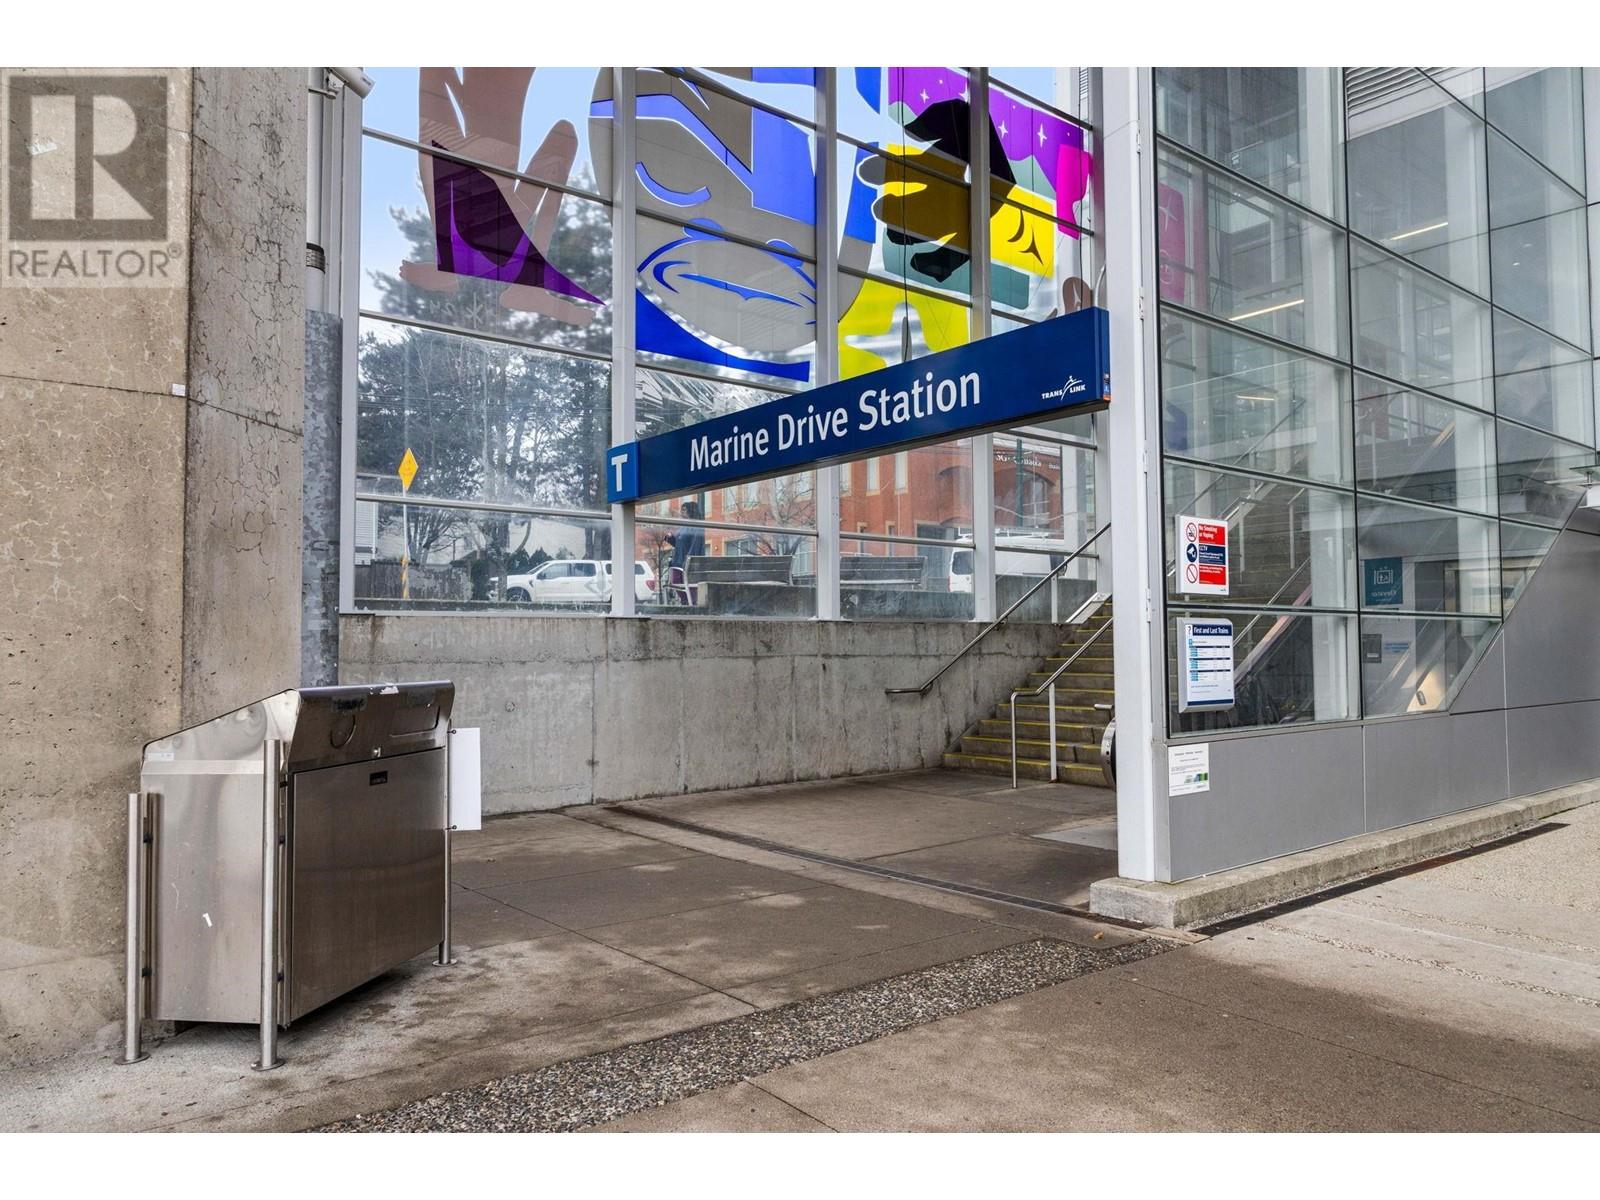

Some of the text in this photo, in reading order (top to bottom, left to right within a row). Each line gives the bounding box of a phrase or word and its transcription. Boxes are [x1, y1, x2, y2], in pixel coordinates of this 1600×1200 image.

[1041, 384, 1086, 400] TRANS LINK
[690, 371, 980, 472] Marine Drive Station
[611, 453, 628, 492] T
